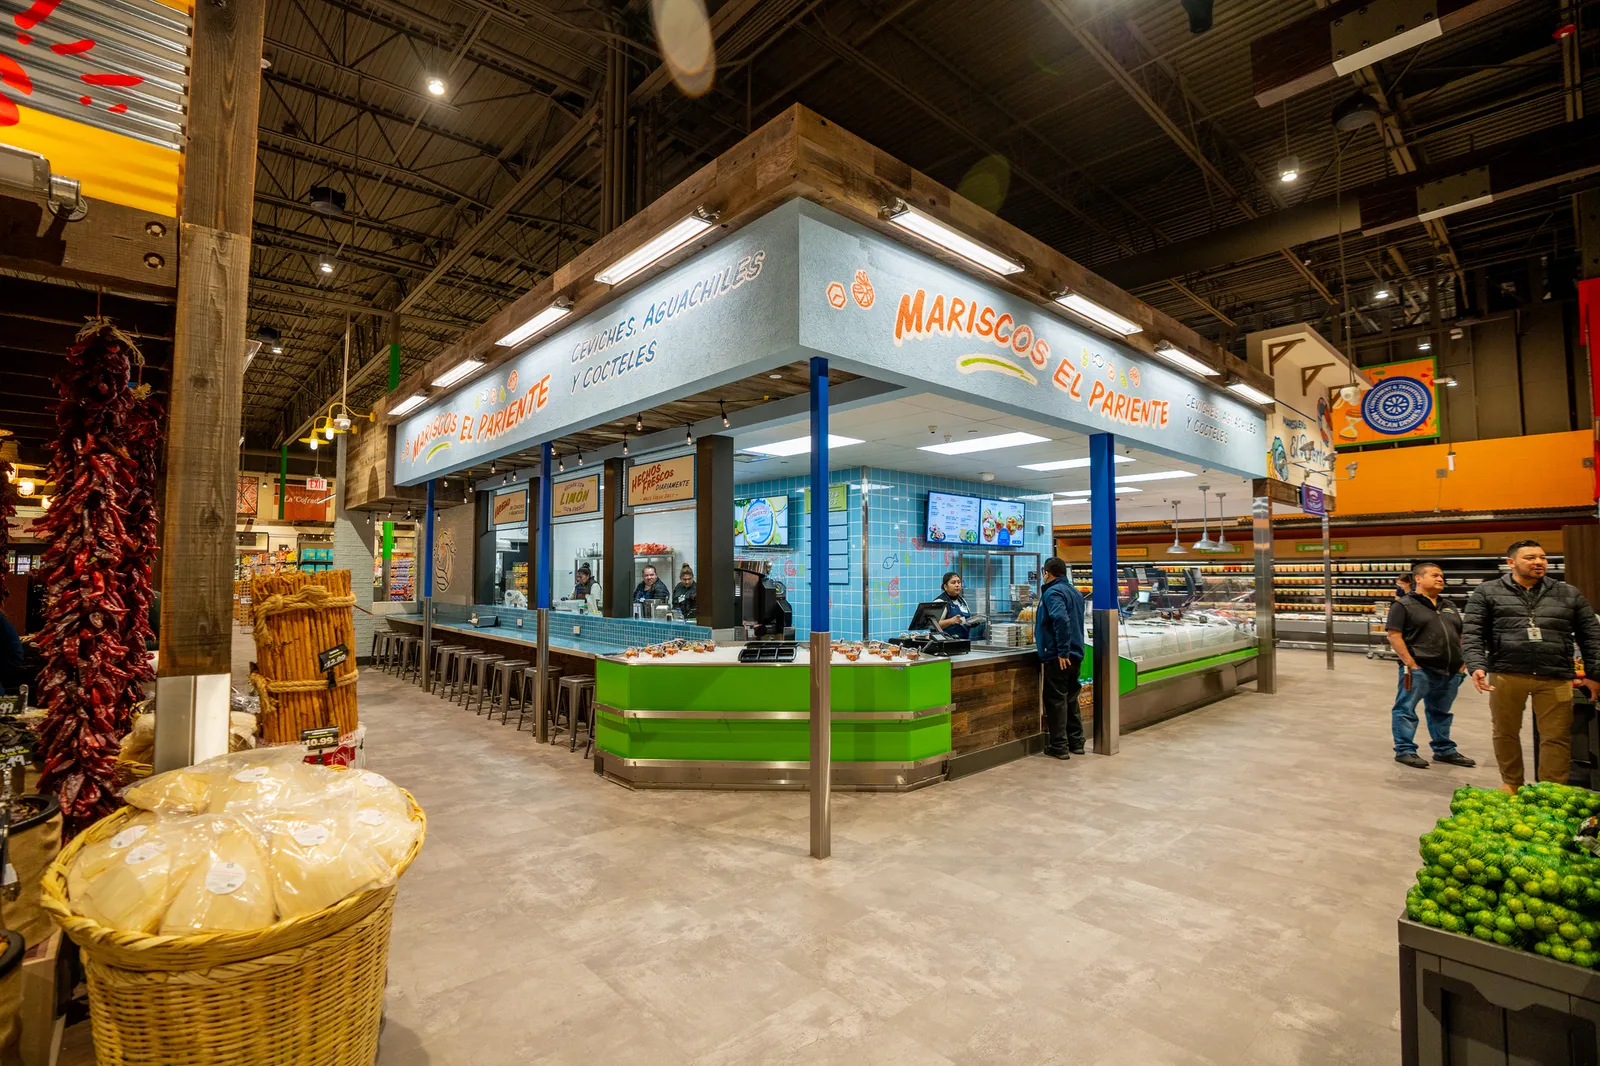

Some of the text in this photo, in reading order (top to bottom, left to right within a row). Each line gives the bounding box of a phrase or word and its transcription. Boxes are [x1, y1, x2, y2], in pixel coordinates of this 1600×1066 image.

[571, 251, 766, 364] CEVICHES, AGUACHILES
[571, 340, 658, 395] Y COCTELES
[893, 288, 1170, 430] MARISCOS EL PARIENTE
[411, 373, 552, 466] MARISCOS EL PARIENTE
[1186, 416, 1229, 444] Y COCTELES
[309, 479, 325, 489] EXIT
[631, 464, 661, 493] HECHOS
[642, 469, 674, 495] FRESCOS
[655, 479, 690, 491] DIARIAMENTE
[560, 487, 589, 506] LIMÓN
